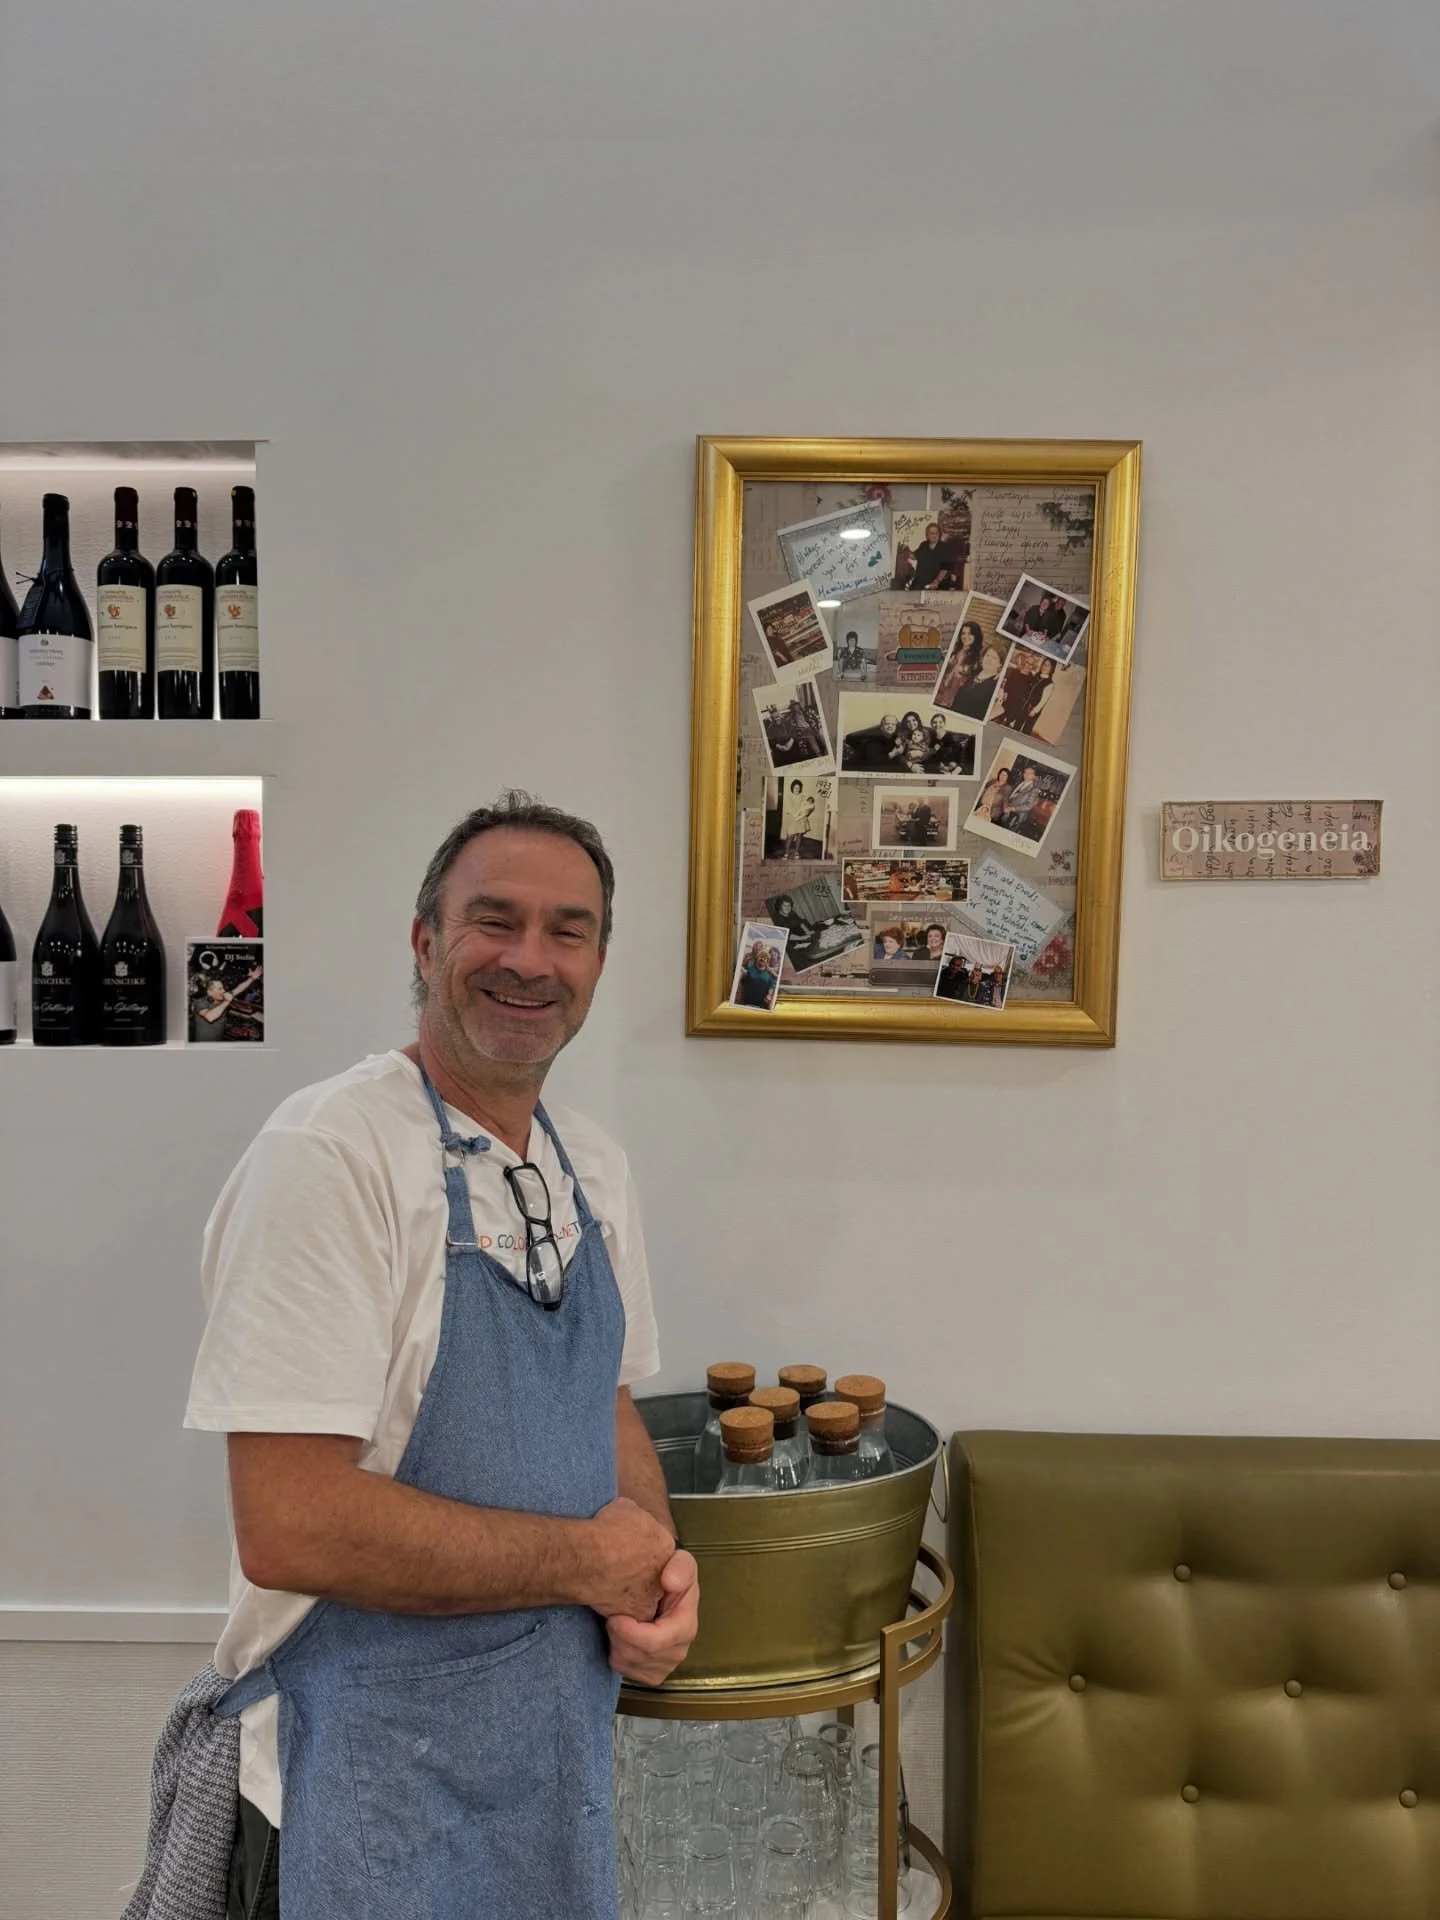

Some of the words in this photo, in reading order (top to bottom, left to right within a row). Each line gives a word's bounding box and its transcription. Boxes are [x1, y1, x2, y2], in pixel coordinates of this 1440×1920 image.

[900, 672, 936, 681] KITCHEN
[1171, 823, 1371, 860] Oikogeneia
[224, 954, 234, 962] DJ
